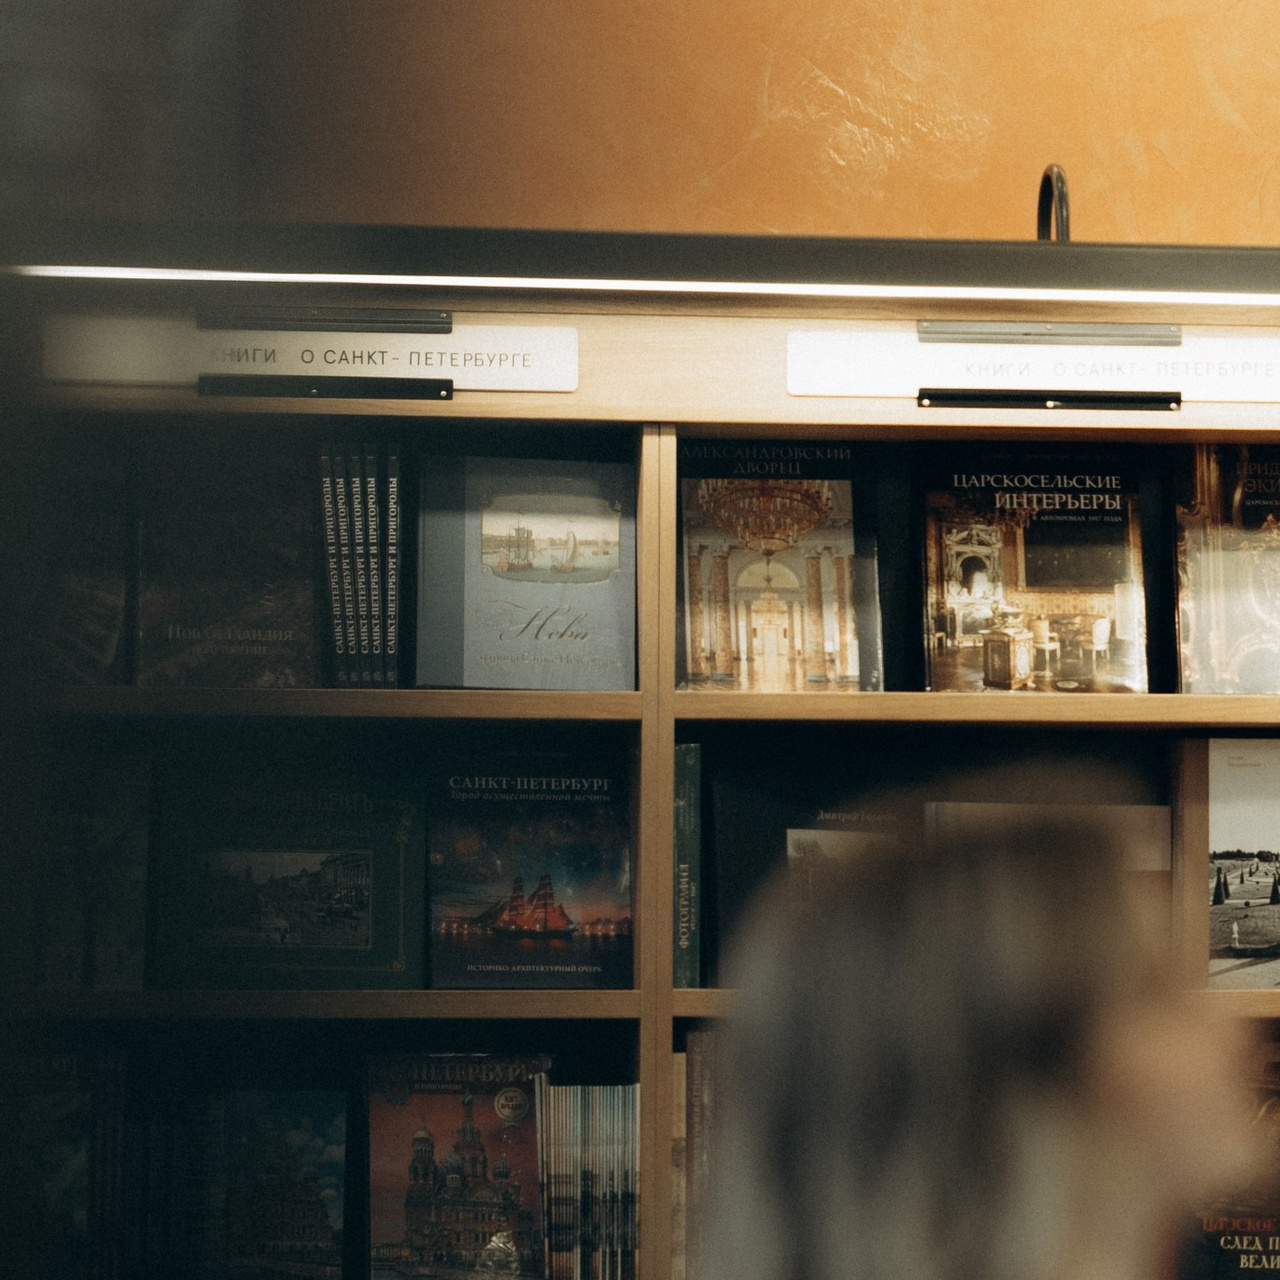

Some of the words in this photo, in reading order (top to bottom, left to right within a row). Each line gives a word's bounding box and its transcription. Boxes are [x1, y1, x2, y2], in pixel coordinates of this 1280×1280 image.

[301, 348, 315, 365] О
[408, 350, 533, 369] ПЕТЕРБУРГЕ
[1156, 361, 1276, 379] ПЕТЕРБУРГЕ
[952, 473, 1122, 490] ЦАРСКОСЕЛЬСКИЕ
[994, 492, 1122, 510] ИНТЕРЬЕРЫ
[449, 776, 612, 791] САНКТ-ПЕТЕРБУРГ
[1220, 1235, 1263, 1252] СЛЕД
